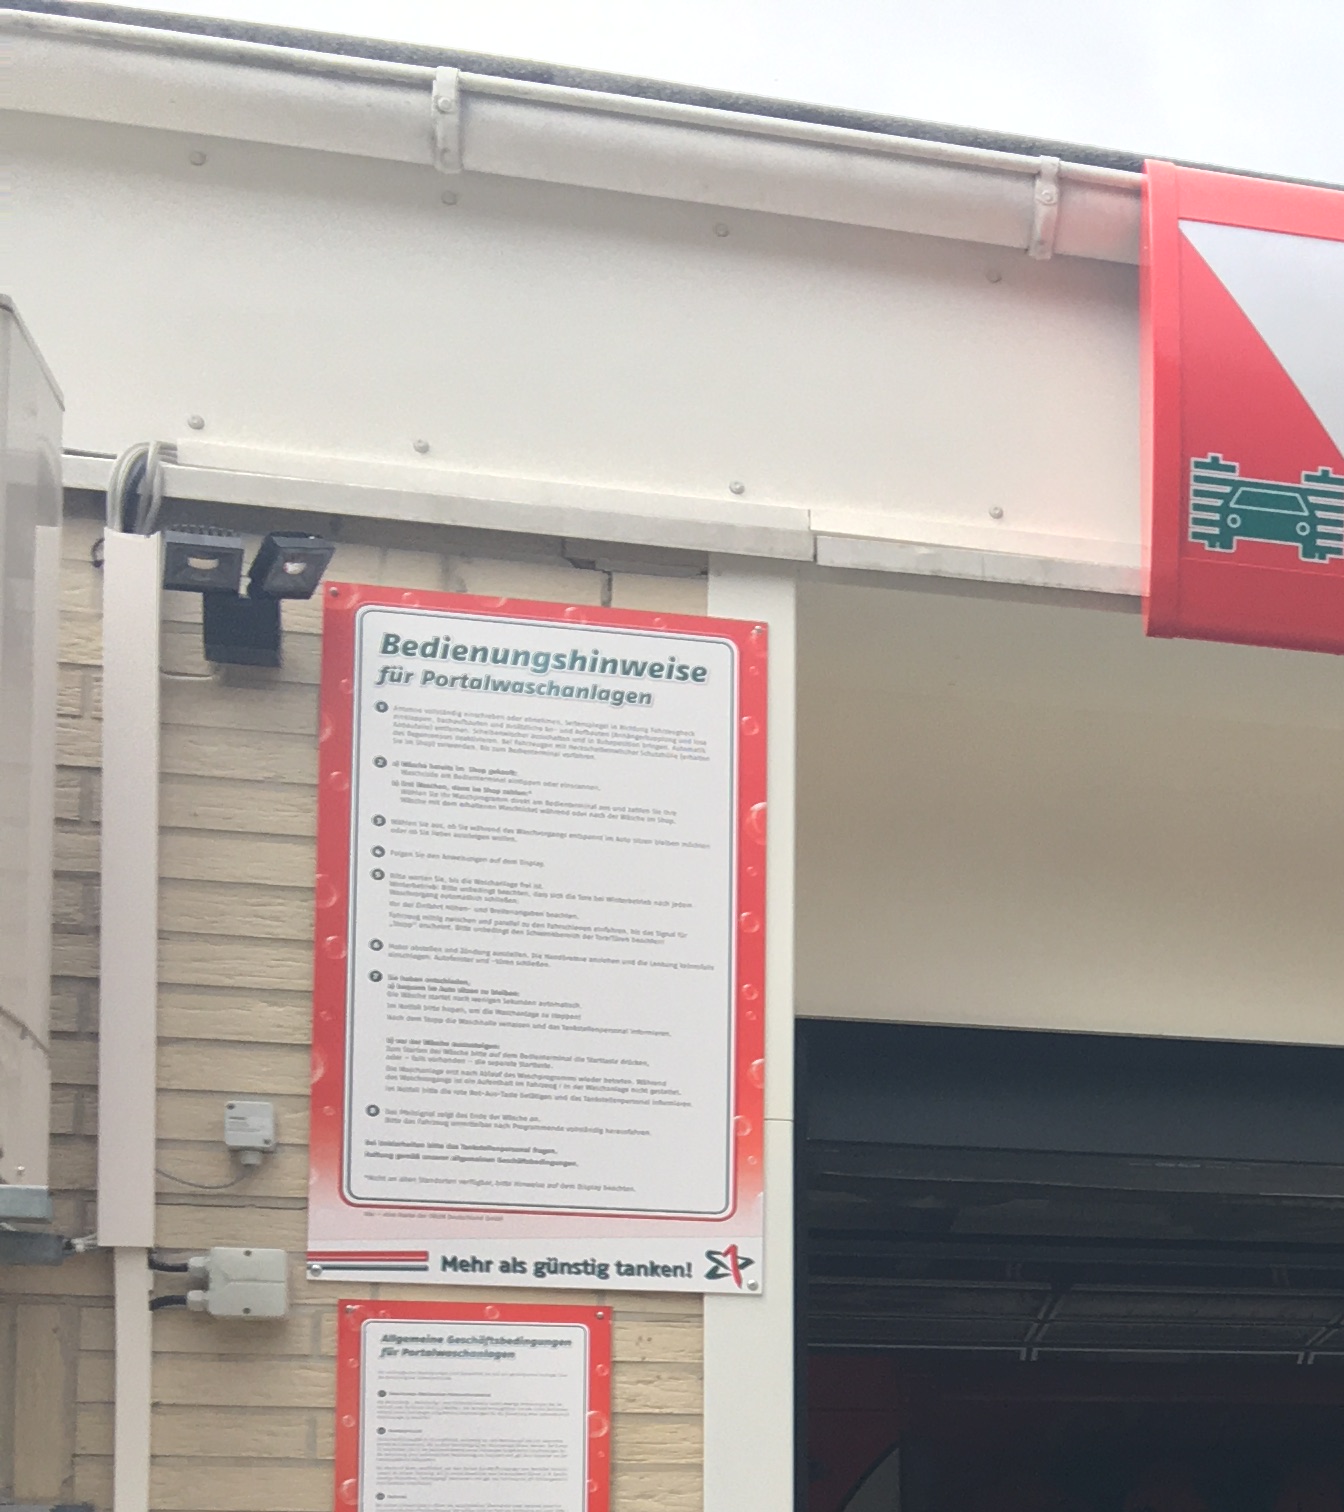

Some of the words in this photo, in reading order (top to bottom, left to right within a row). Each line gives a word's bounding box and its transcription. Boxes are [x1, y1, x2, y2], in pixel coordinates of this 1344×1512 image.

[379, 632, 708, 684] Bedienungshinweise
[376, 665, 414, 686] für
[420, 668, 653, 707] Portalwaschanlagen
[440, 1255, 494, 1275] Mehr
[499, 1255, 527, 1275] als
[533, 1256, 610, 1280] günstig
[614, 1258, 692, 1279] tanken!
